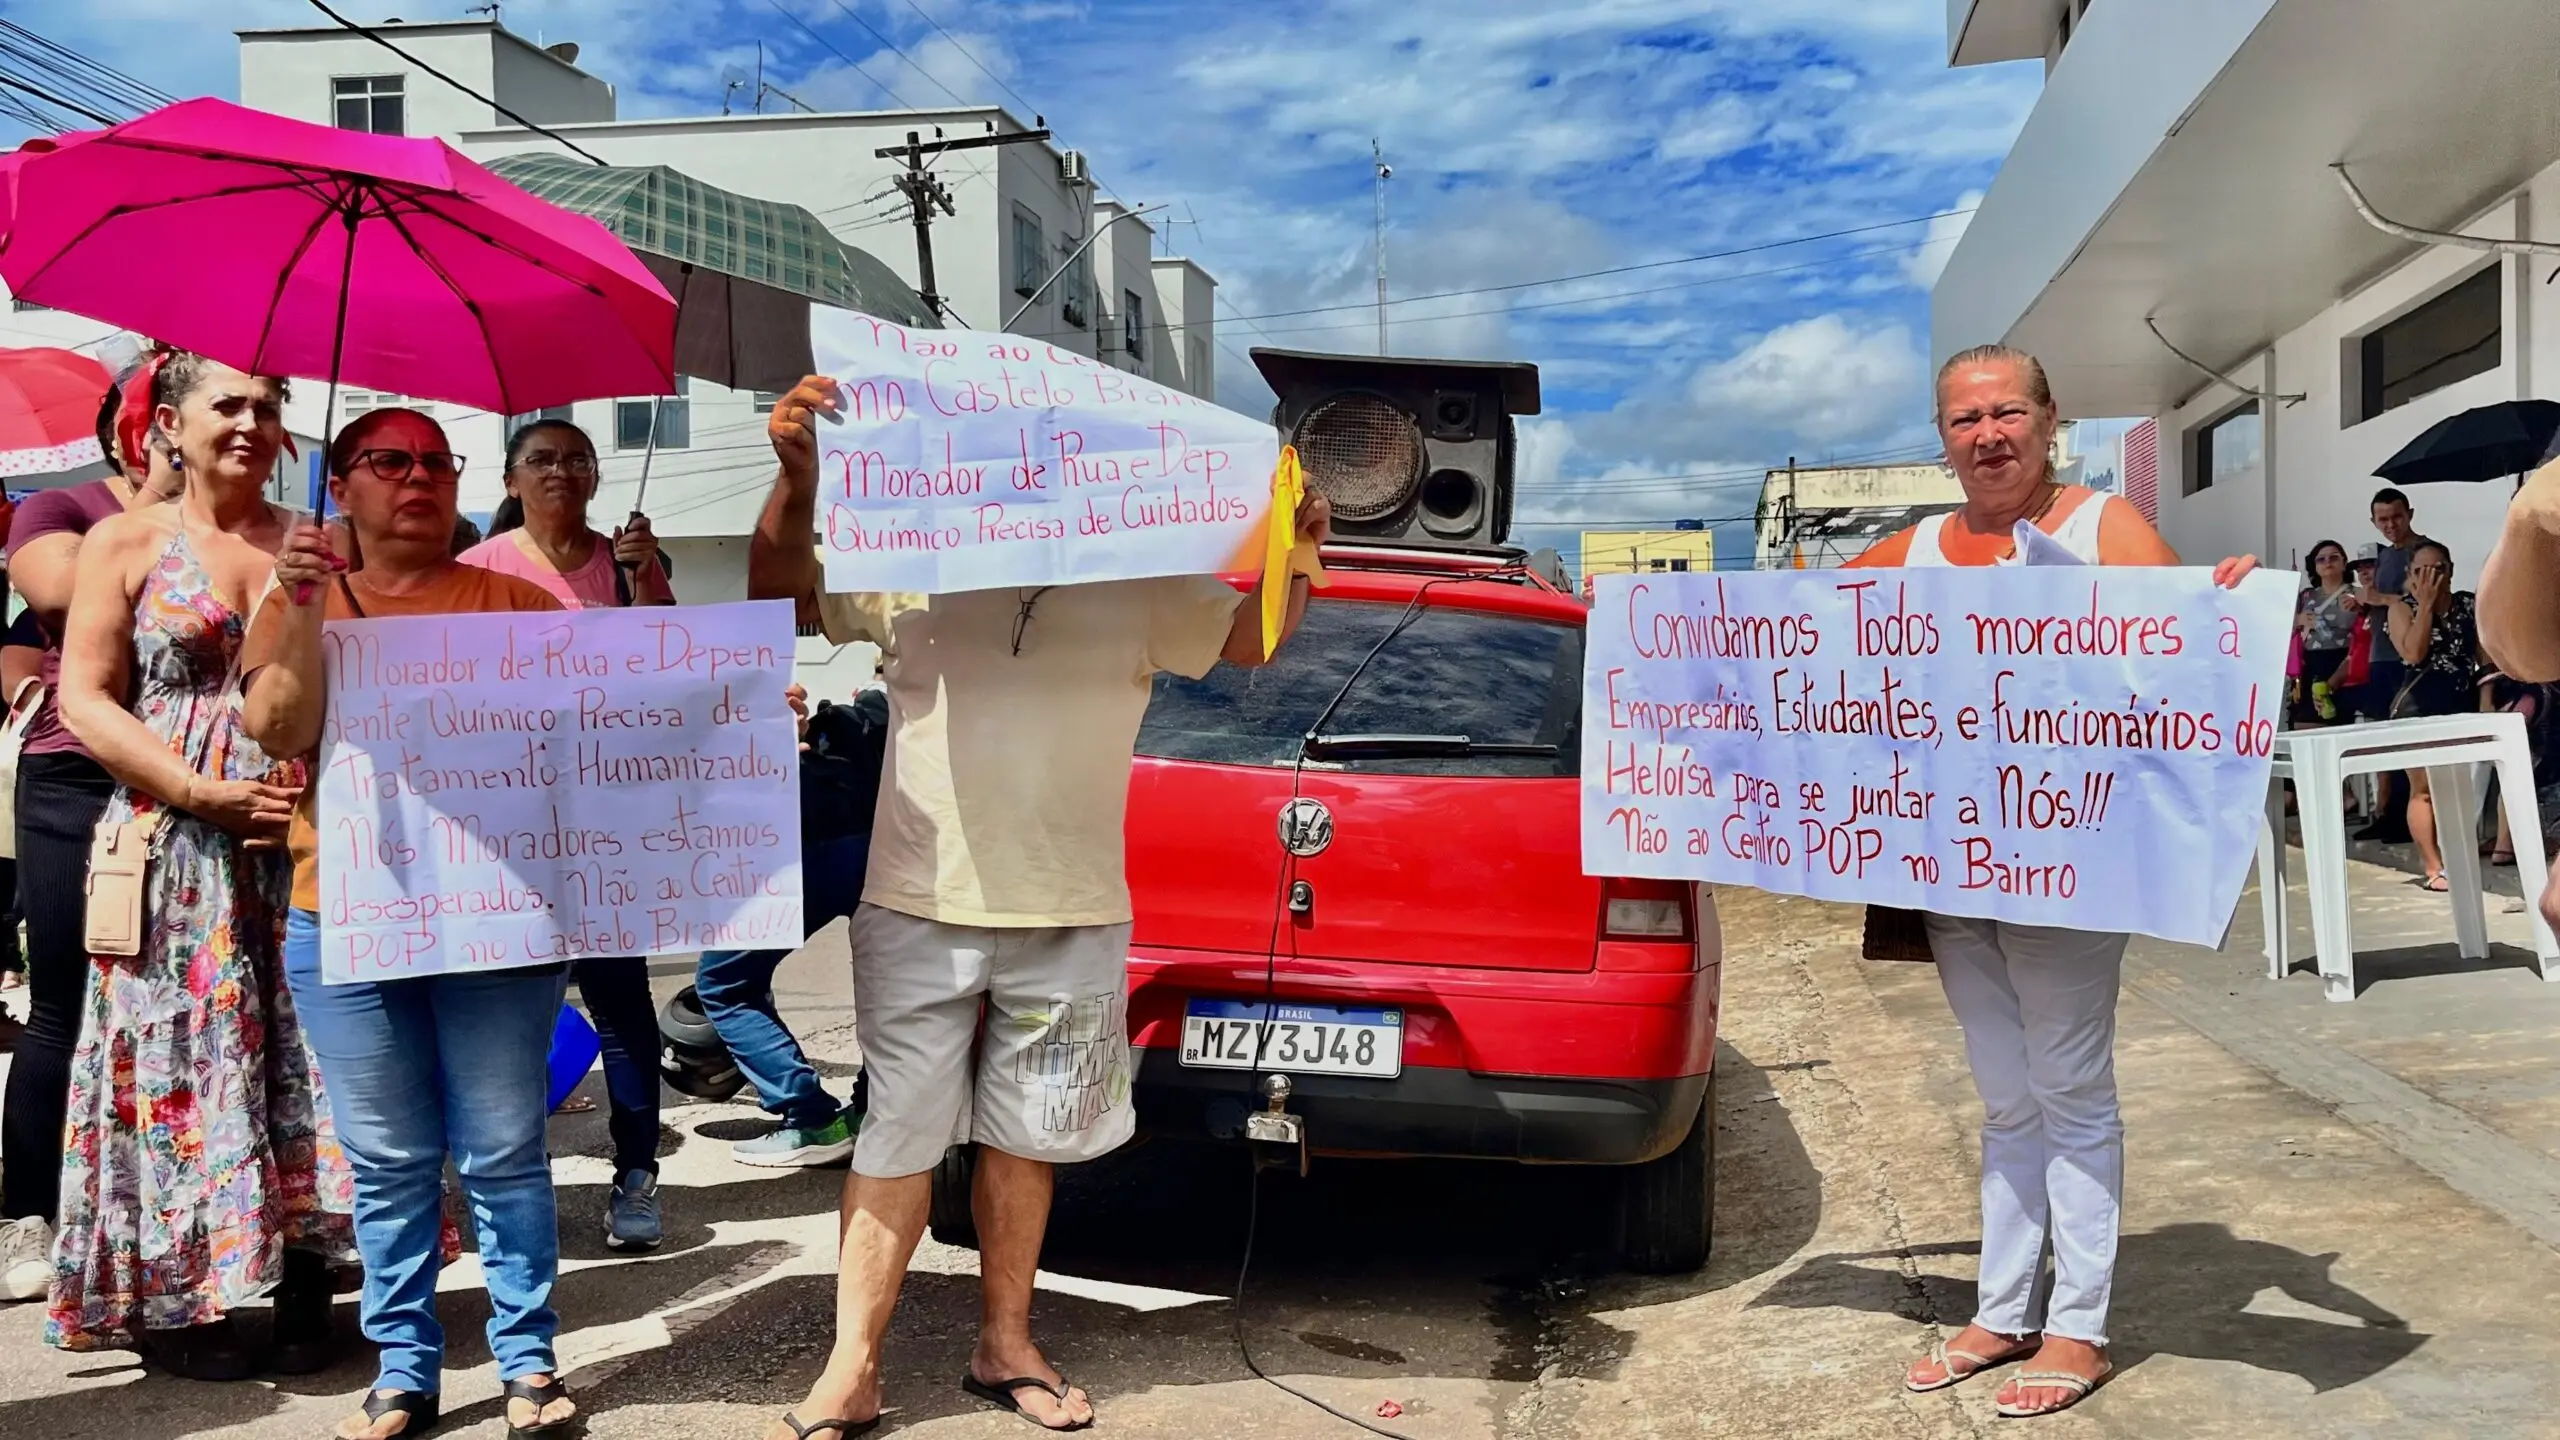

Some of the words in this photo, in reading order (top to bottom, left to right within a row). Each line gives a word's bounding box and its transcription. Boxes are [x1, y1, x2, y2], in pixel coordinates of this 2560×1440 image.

[988, 344, 1030, 361] ao
[837, 376, 905, 421] no
[925, 359, 1074, 416] Castelo
[826, 431, 986, 498] Morador
[1013, 428, 1047, 491] de
[1051, 430, 1121, 489] Rua
[1130, 457, 1151, 480] e
[827, 503, 961, 552] Químico
[1078, 501, 1113, 536] de
[1121, 486, 1248, 529] Cuidados
[1629, 577, 1819, 660] Convidamos
[1837, 580, 1940, 657] Todos
[1965, 580, 2183, 658] moradores
[2219, 616, 2241, 658] a
[322, 627, 479, 690] Morador
[501, 625, 535, 680] de
[538, 624, 609, 677] Rua
[626, 653, 644, 673] e
[325, 694, 410, 746] dente
[430, 689, 556, 738] Químico
[712, 685, 751, 725] de
[1606, 667, 1762, 745] Empresários,
[1772, 666, 1945, 751] Estudantes,
[1957, 707, 1979, 741] e
[2235, 683, 2272, 758] do
[332, 742, 558, 801] Tratamento
[1606, 741, 1715, 799] Heloísa
[1732, 773, 1779, 814] para
[1800, 780, 1824, 811] se
[1842, 749, 1935, 826] juntar
[1958, 796, 1979, 825] a
[432, 805, 623, 864] Moradores
[640, 796, 780, 853] estamos
[1688, 826, 1710, 856] ao
[1723, 813, 1791, 867] Centro
[1799, 819, 1883, 878] POP
[1901, 855, 1940, 886] no
[1950, 836, 2077, 900] Bairro
[657, 879, 683, 900] ao
[691, 851, 780, 899] Centro
[341, 933, 435, 975] POP
[460, 933, 507, 964] no
[525, 914, 635, 959] Castelo
[1202, 1020, 1375, 1066] MZY3J48
[1278, 1009, 1312, 1020] BRASIL
[1186, 1048, 1198, 1061] BR
